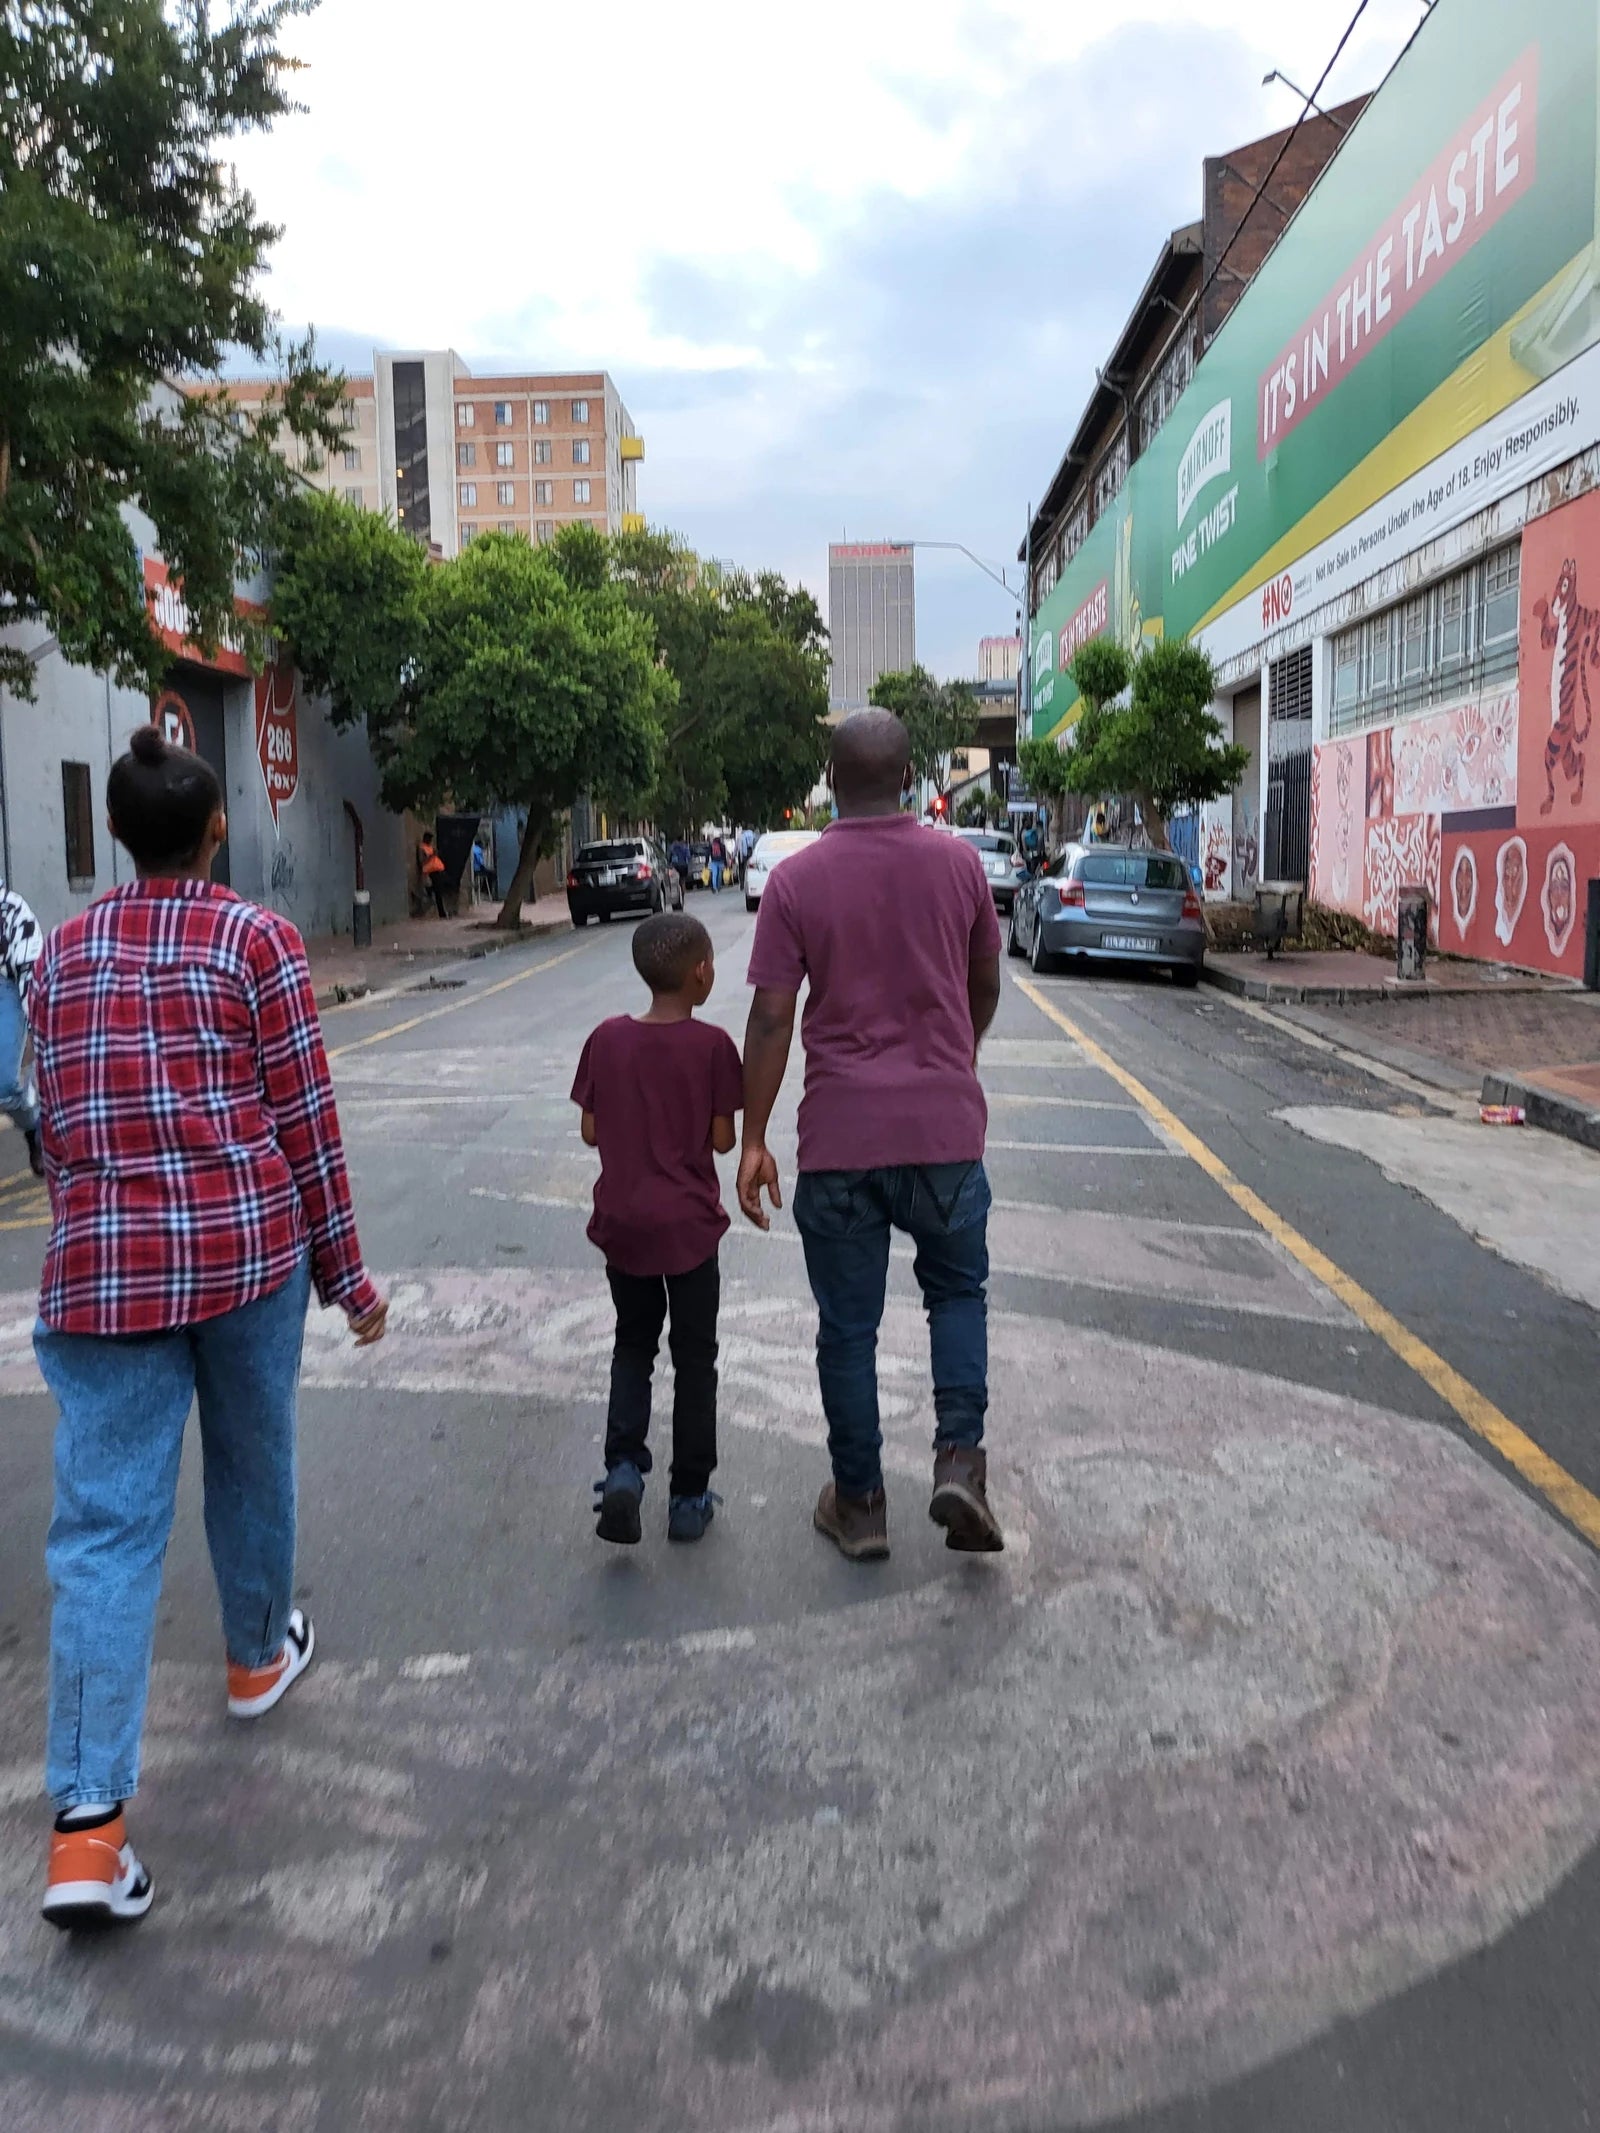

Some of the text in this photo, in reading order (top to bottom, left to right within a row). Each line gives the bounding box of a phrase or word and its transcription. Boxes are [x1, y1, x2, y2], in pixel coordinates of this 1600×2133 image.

[1263, 82, 1522, 445] IT'S IN THE TASTE
[1181, 417, 1226, 506] SMIRNOFF
[1315, 396, 1580, 583] Not for Sale to Persons Under the Age of 18. Enjoy Responsibly.
[1170, 481, 1239, 587] PINE TWIST
[1087, 584, 1106, 637] TASTE
